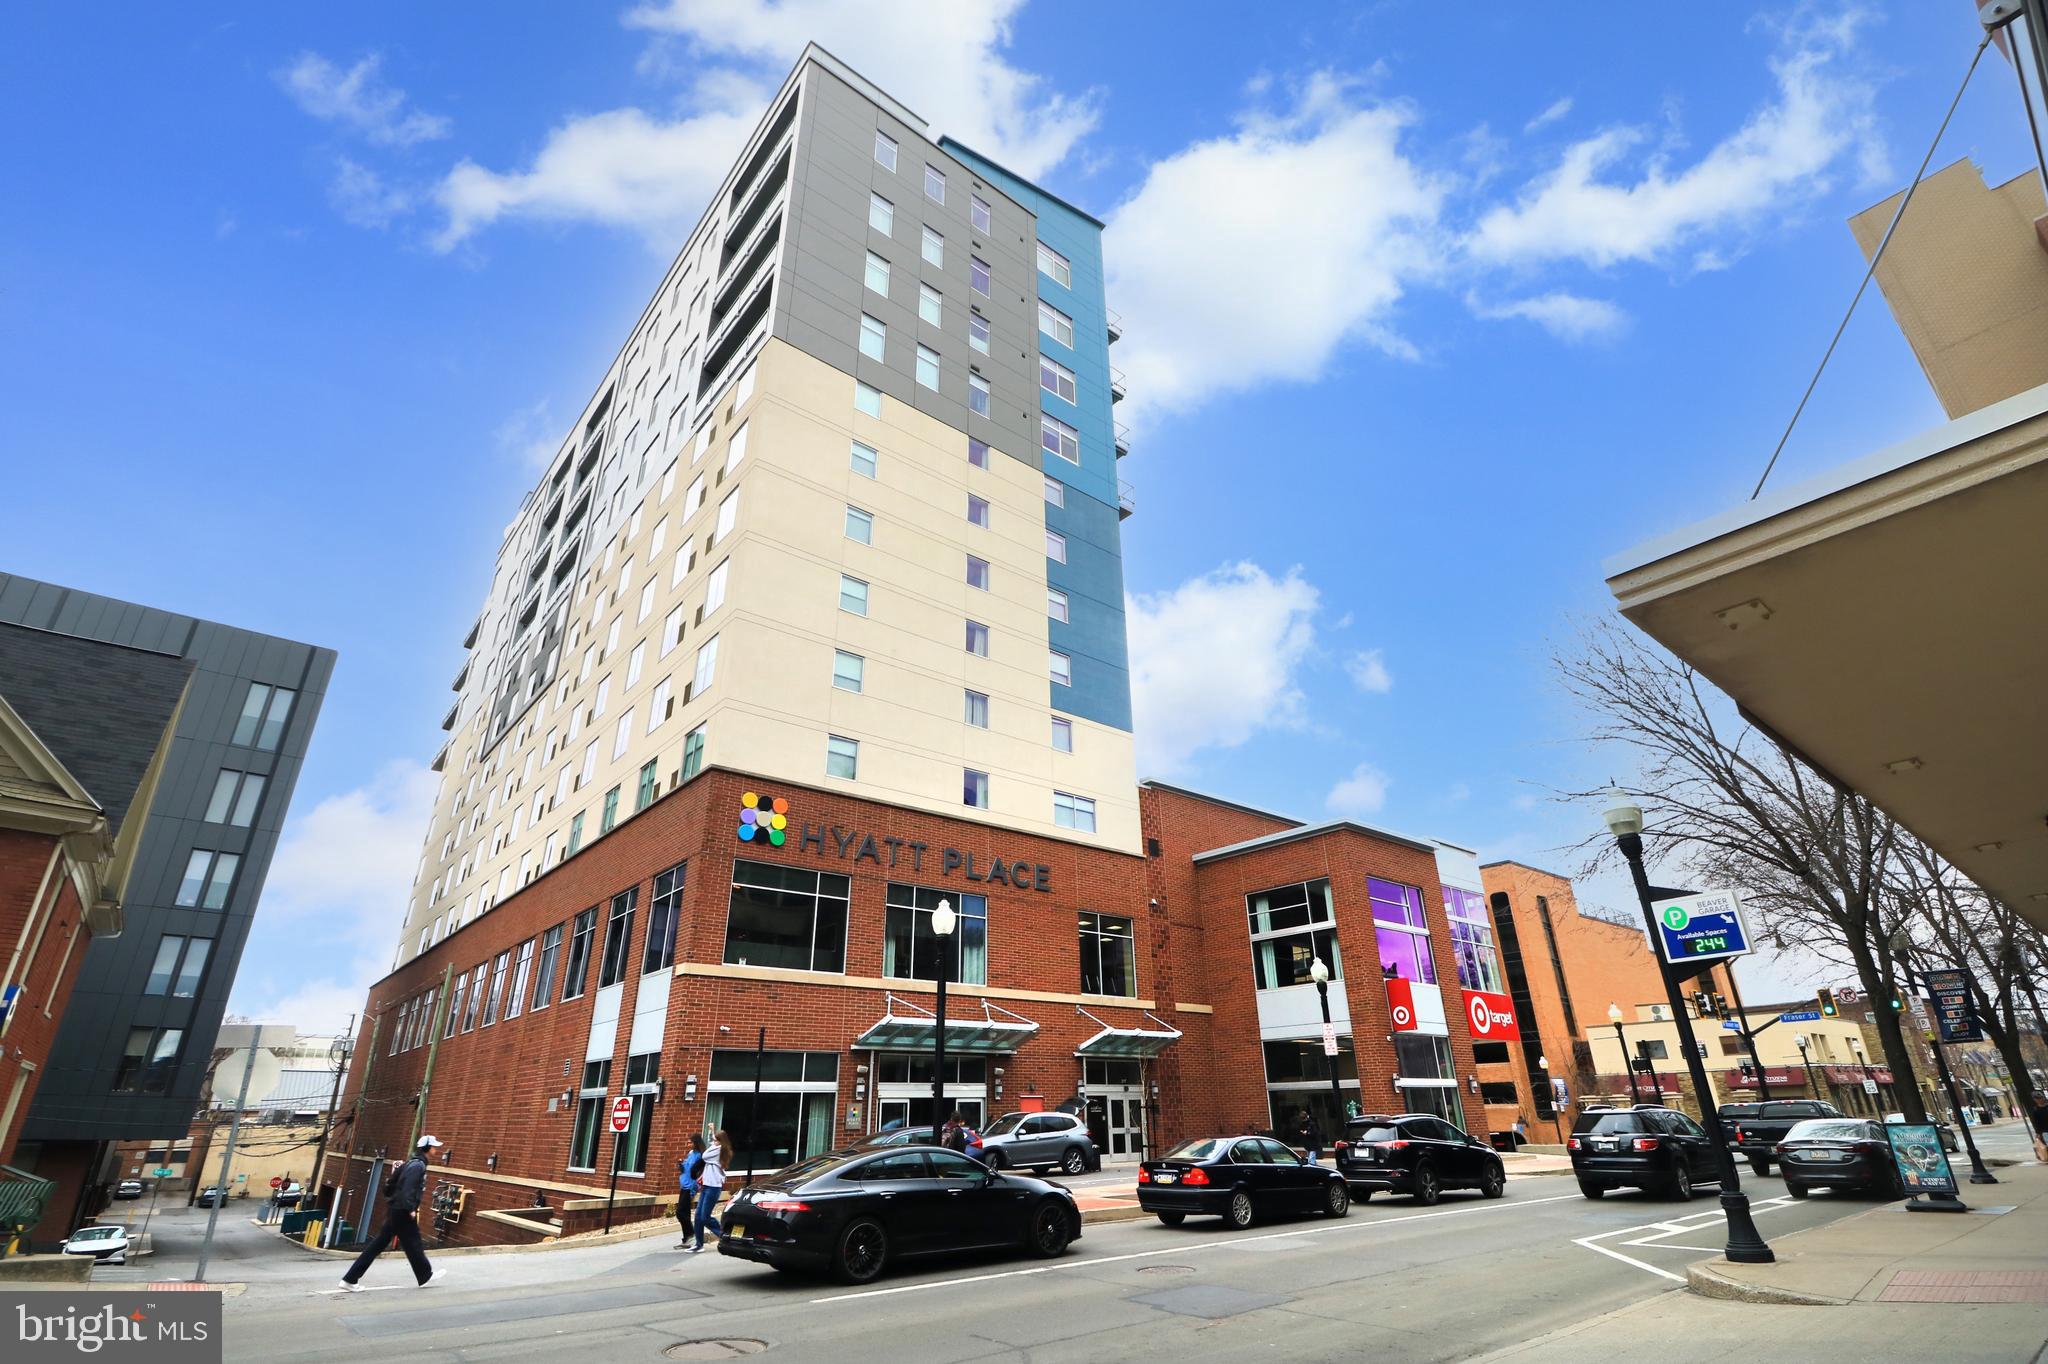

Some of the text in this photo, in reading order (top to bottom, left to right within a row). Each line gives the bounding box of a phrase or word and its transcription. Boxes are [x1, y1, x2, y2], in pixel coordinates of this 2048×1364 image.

[800, 821, 1052, 892] HYATT PLACE
[1697, 898, 1728, 908] BEAVER
[1698, 905, 1730, 915] GARAGE
[1677, 928, 1728, 940] Available Spaces
[1695, 937, 1726, 953] 244
[1490, 1009, 1513, 1027] target
[1783, 1013, 1805, 1021] Fraser
